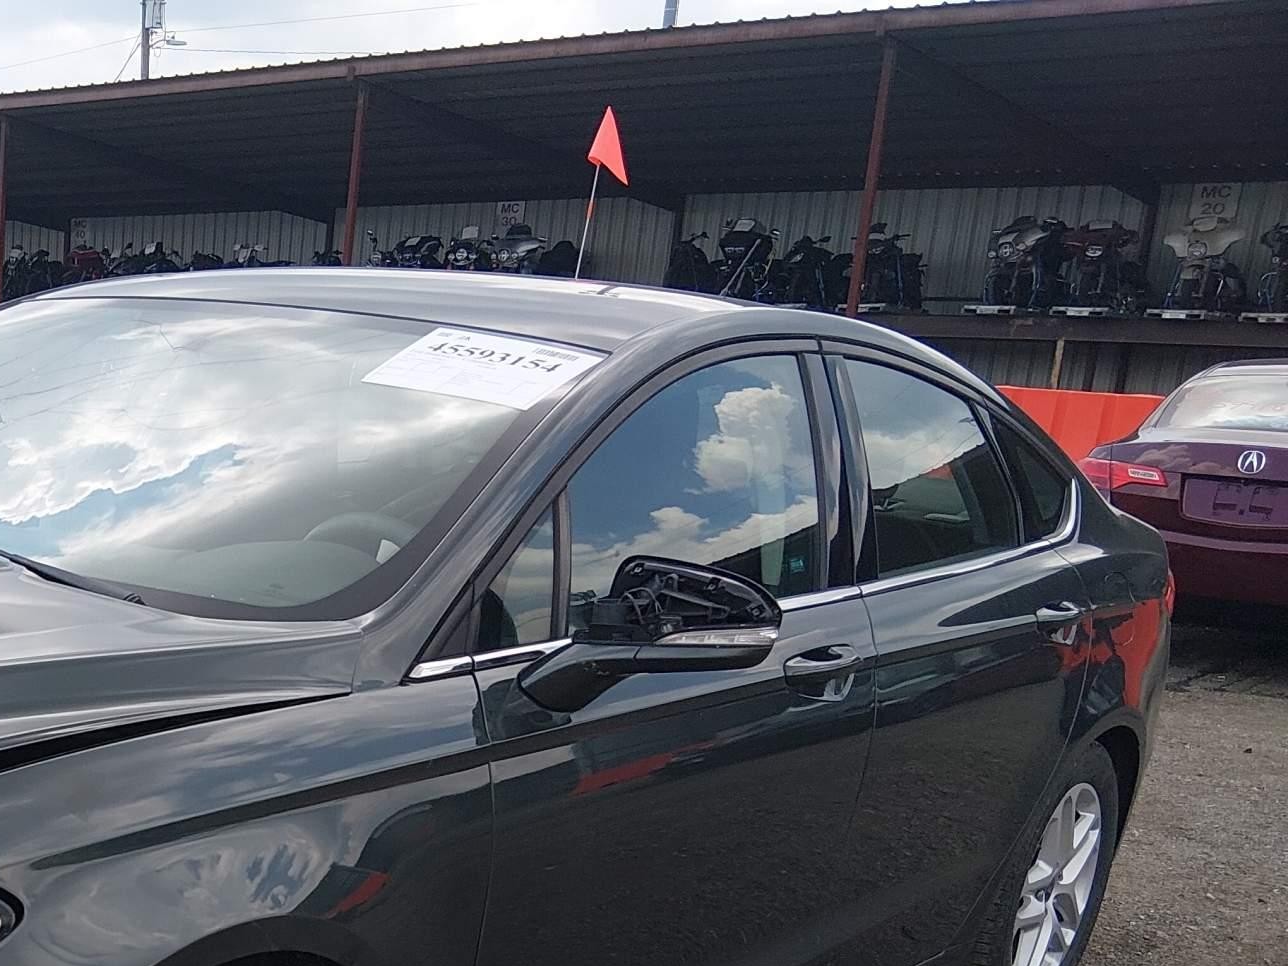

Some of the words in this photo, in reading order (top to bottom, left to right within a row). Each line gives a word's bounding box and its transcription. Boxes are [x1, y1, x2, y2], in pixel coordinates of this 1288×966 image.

[1201, 185, 1231, 198] MC
[501, 203, 520, 214] MC
[1200, 202, 1225, 215] 20
[502, 216, 518, 226] 30
[427, 341, 564, 373] 45593154
